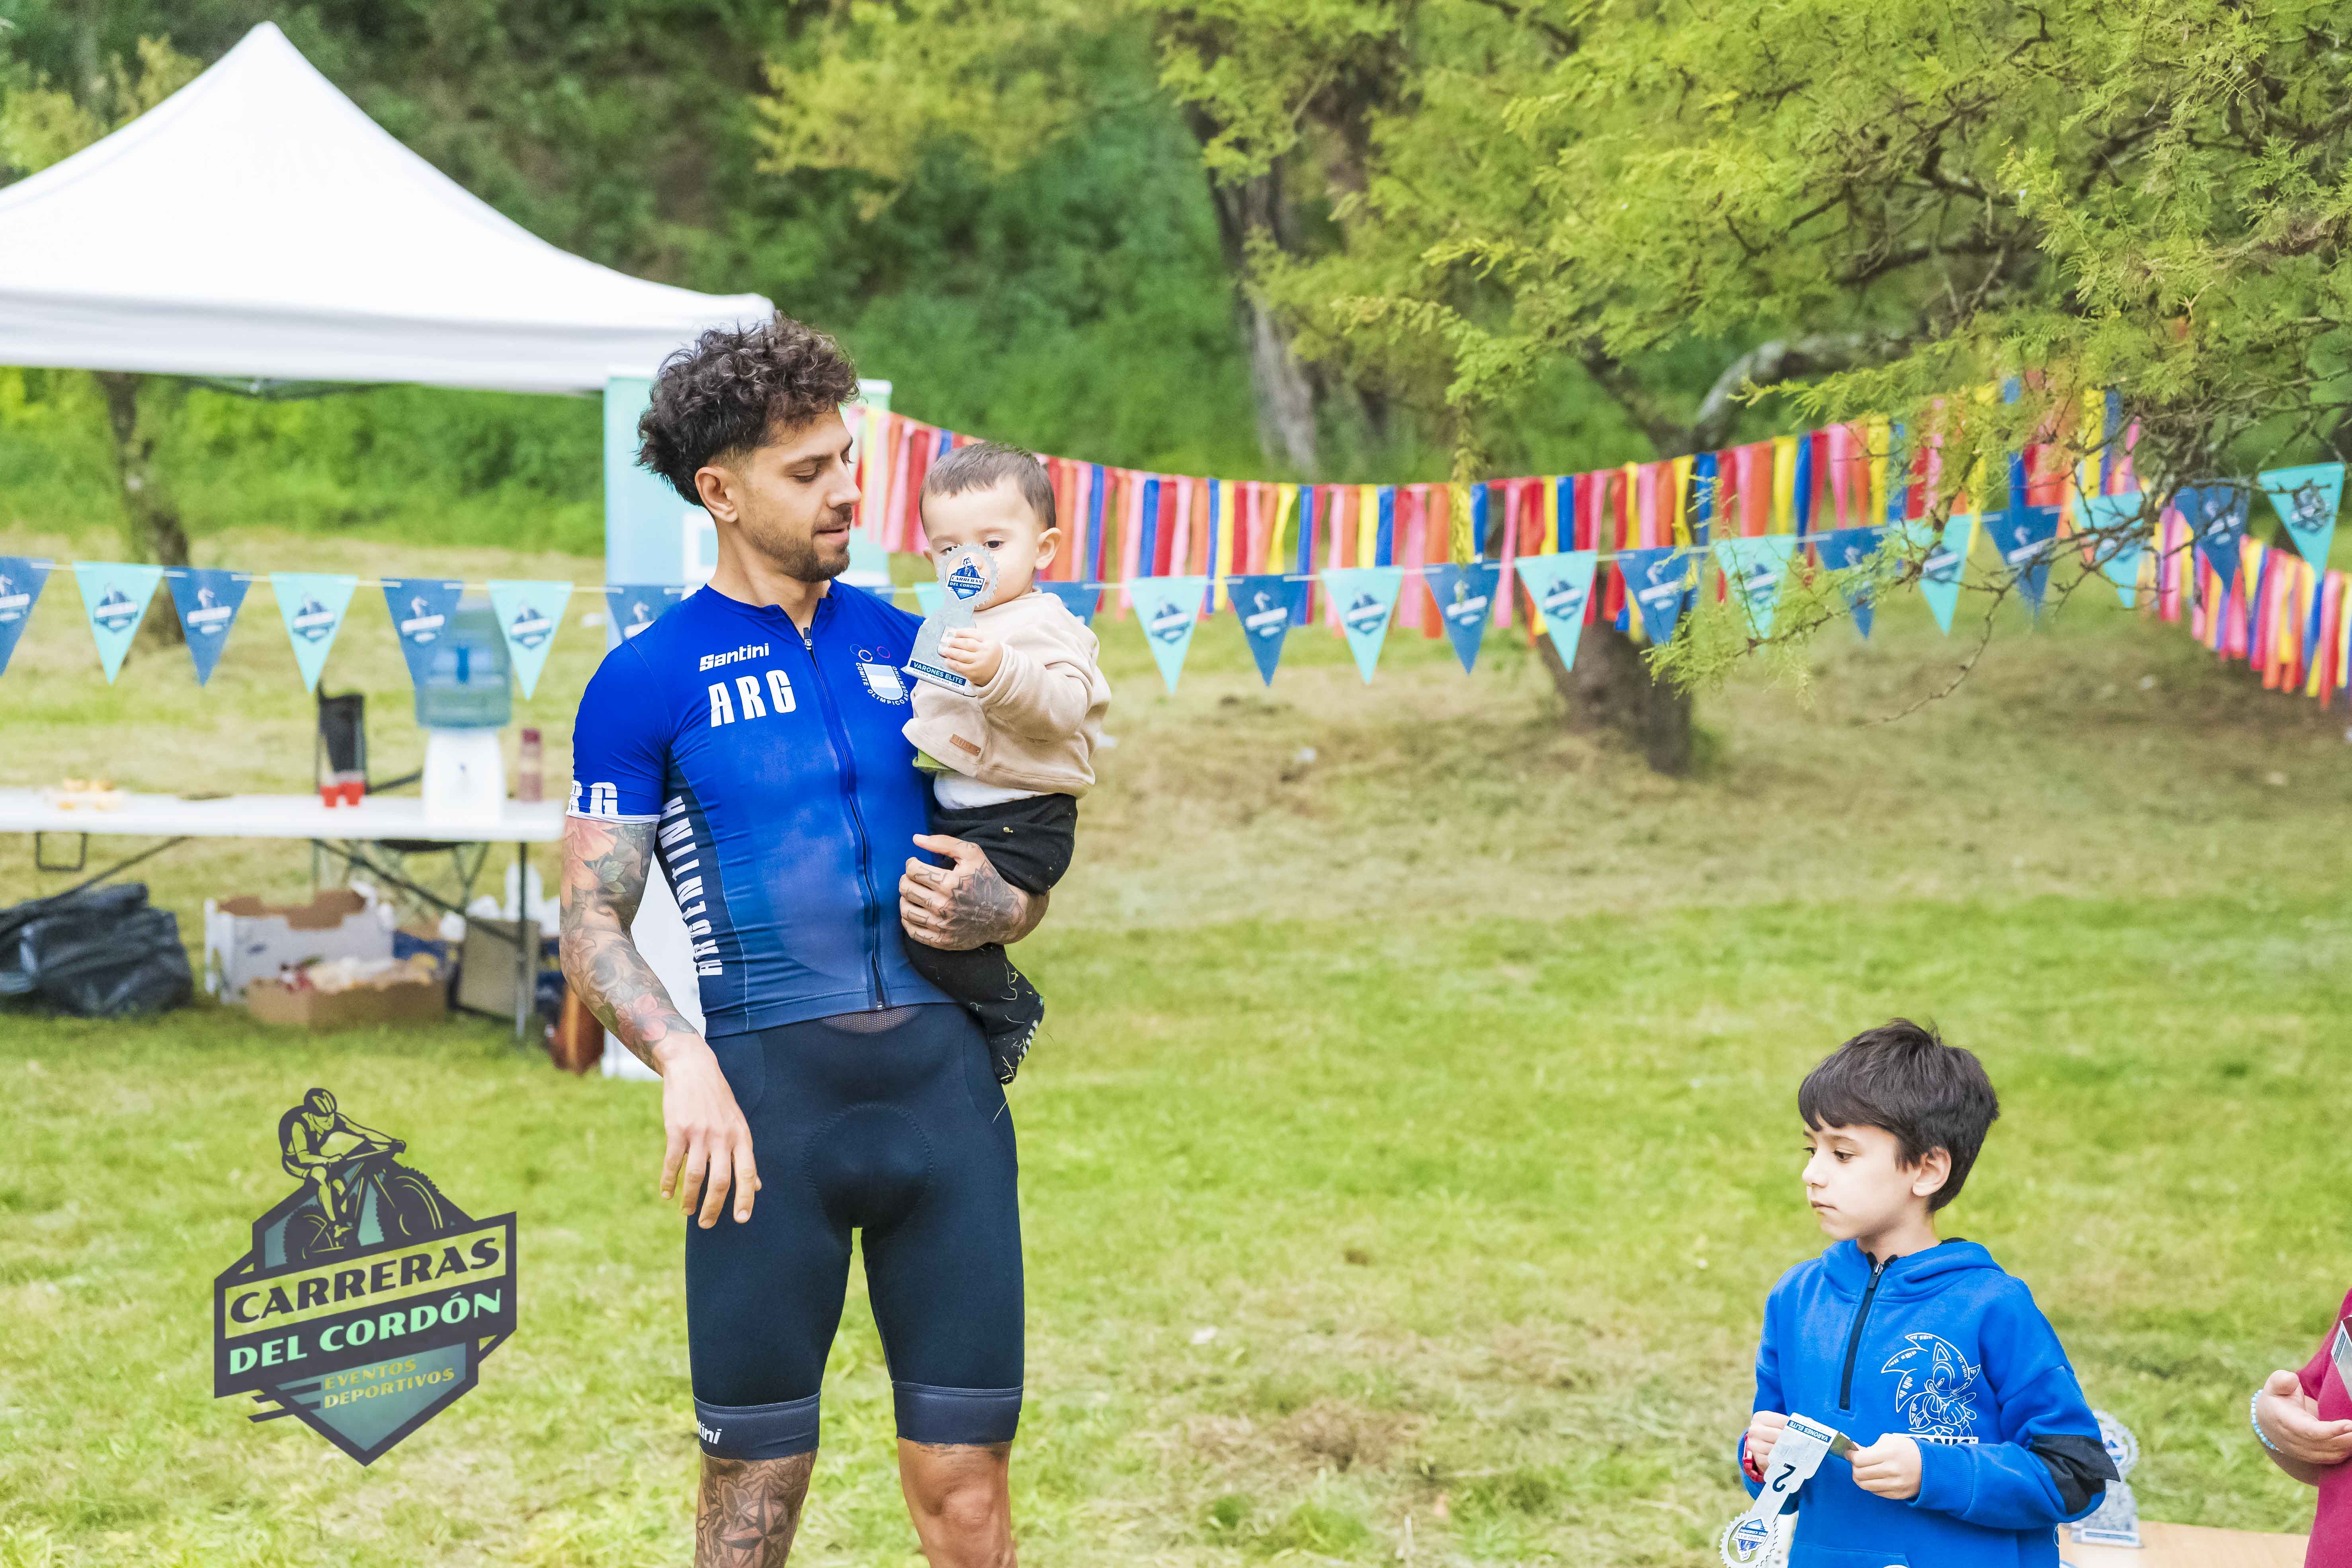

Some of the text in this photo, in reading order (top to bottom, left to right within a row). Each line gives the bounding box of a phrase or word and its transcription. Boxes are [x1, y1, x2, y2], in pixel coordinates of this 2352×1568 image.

[699, 643, 769, 672] Santini
[856, 662, 909, 705] COMITE OLIMPICO ARGENTINO
[914, 662, 963, 684] VARONES ELITE
[708, 670, 796, 728] ARG
[657, 796, 723, 976] ARGENTINA
[1789, 1421, 1804, 1430] ELITE
[1804, 1427, 1828, 1441] VARONES
[1772, 1463, 1797, 1492] 2
